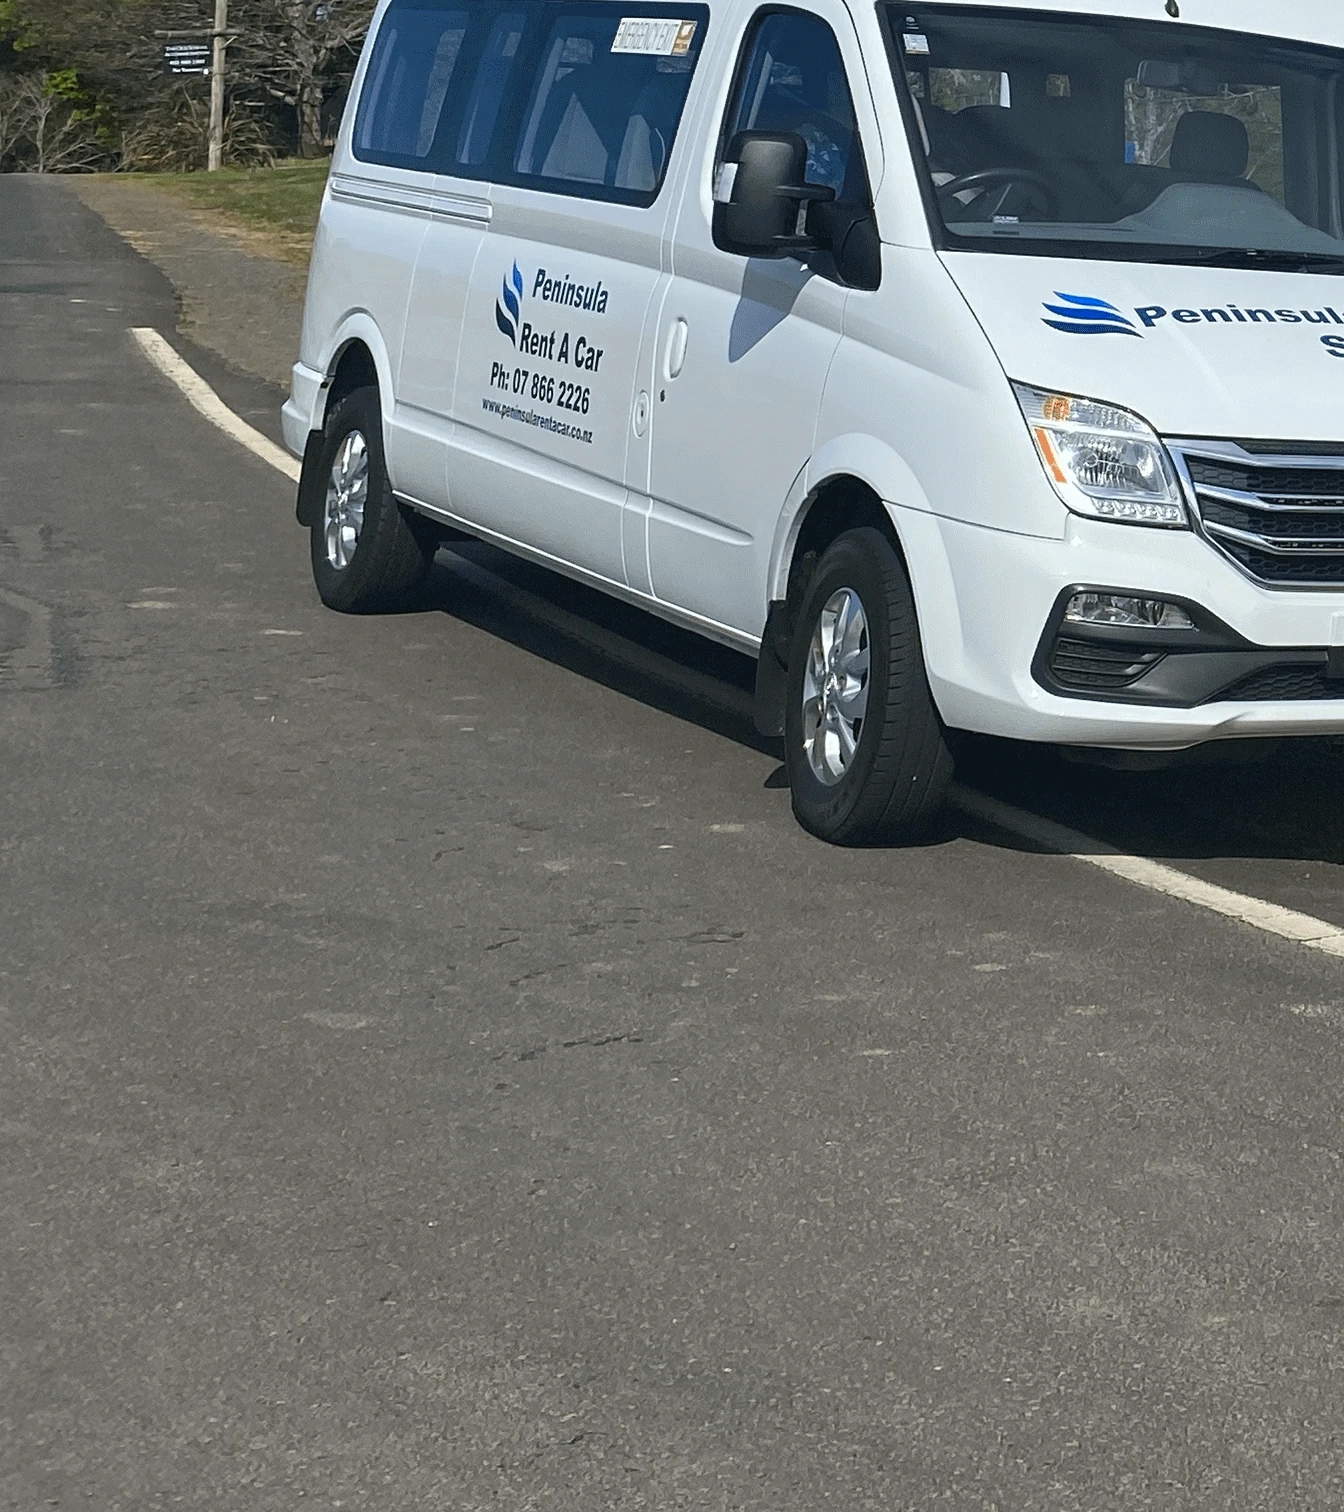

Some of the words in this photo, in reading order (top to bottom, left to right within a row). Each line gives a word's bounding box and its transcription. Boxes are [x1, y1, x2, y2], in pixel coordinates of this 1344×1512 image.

[532, 269, 609, 313] Peninsula
[520, 322, 556, 361] Rent
[557, 332, 569, 364] A
[574, 336, 604, 372] Car
[490, 361, 510, 390] Ph:
[512, 367, 530, 396] 07
[530, 373, 555, 404] 866
[556, 380, 591, 415] 2226
[482, 397, 593, 444] www.peninsularentacar.co.nz
